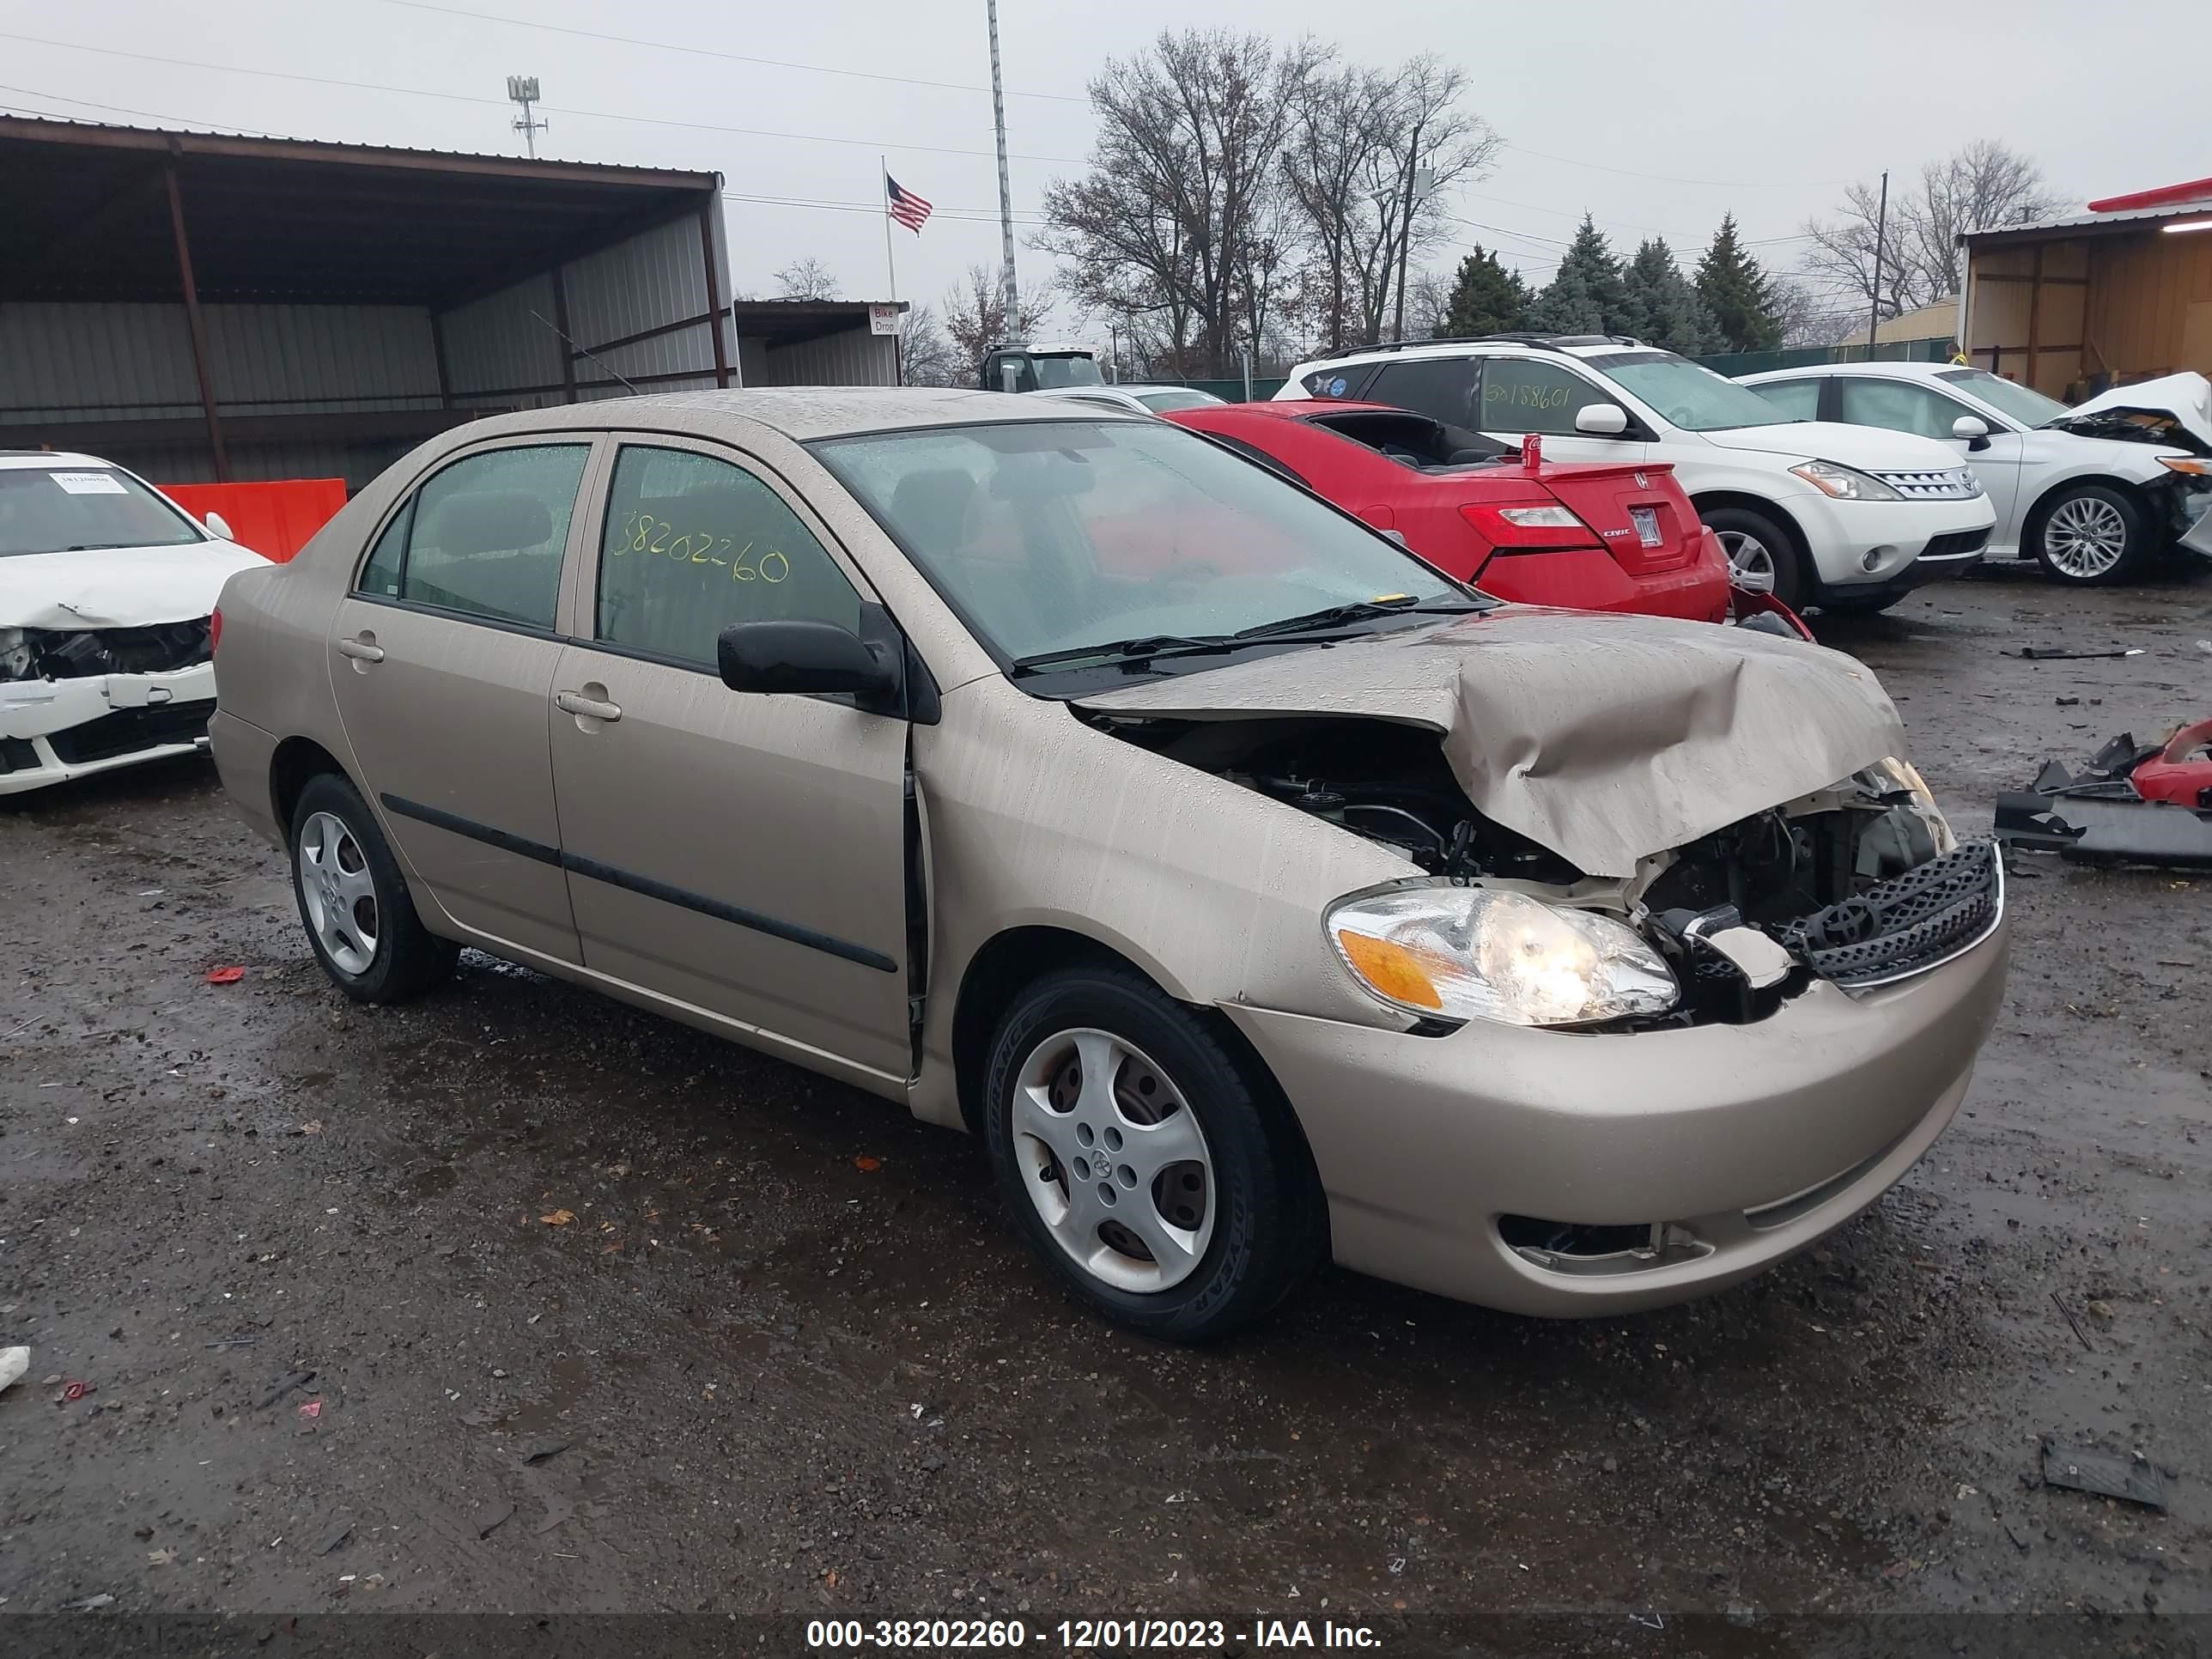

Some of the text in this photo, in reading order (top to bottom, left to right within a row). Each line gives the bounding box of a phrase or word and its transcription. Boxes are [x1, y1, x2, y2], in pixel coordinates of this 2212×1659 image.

[874, 308, 893, 318] Bike
[876, 321, 894, 332] Drop
[1603, 528, 1632, 538] CIVIC
[611, 509, 789, 583] 38202260
